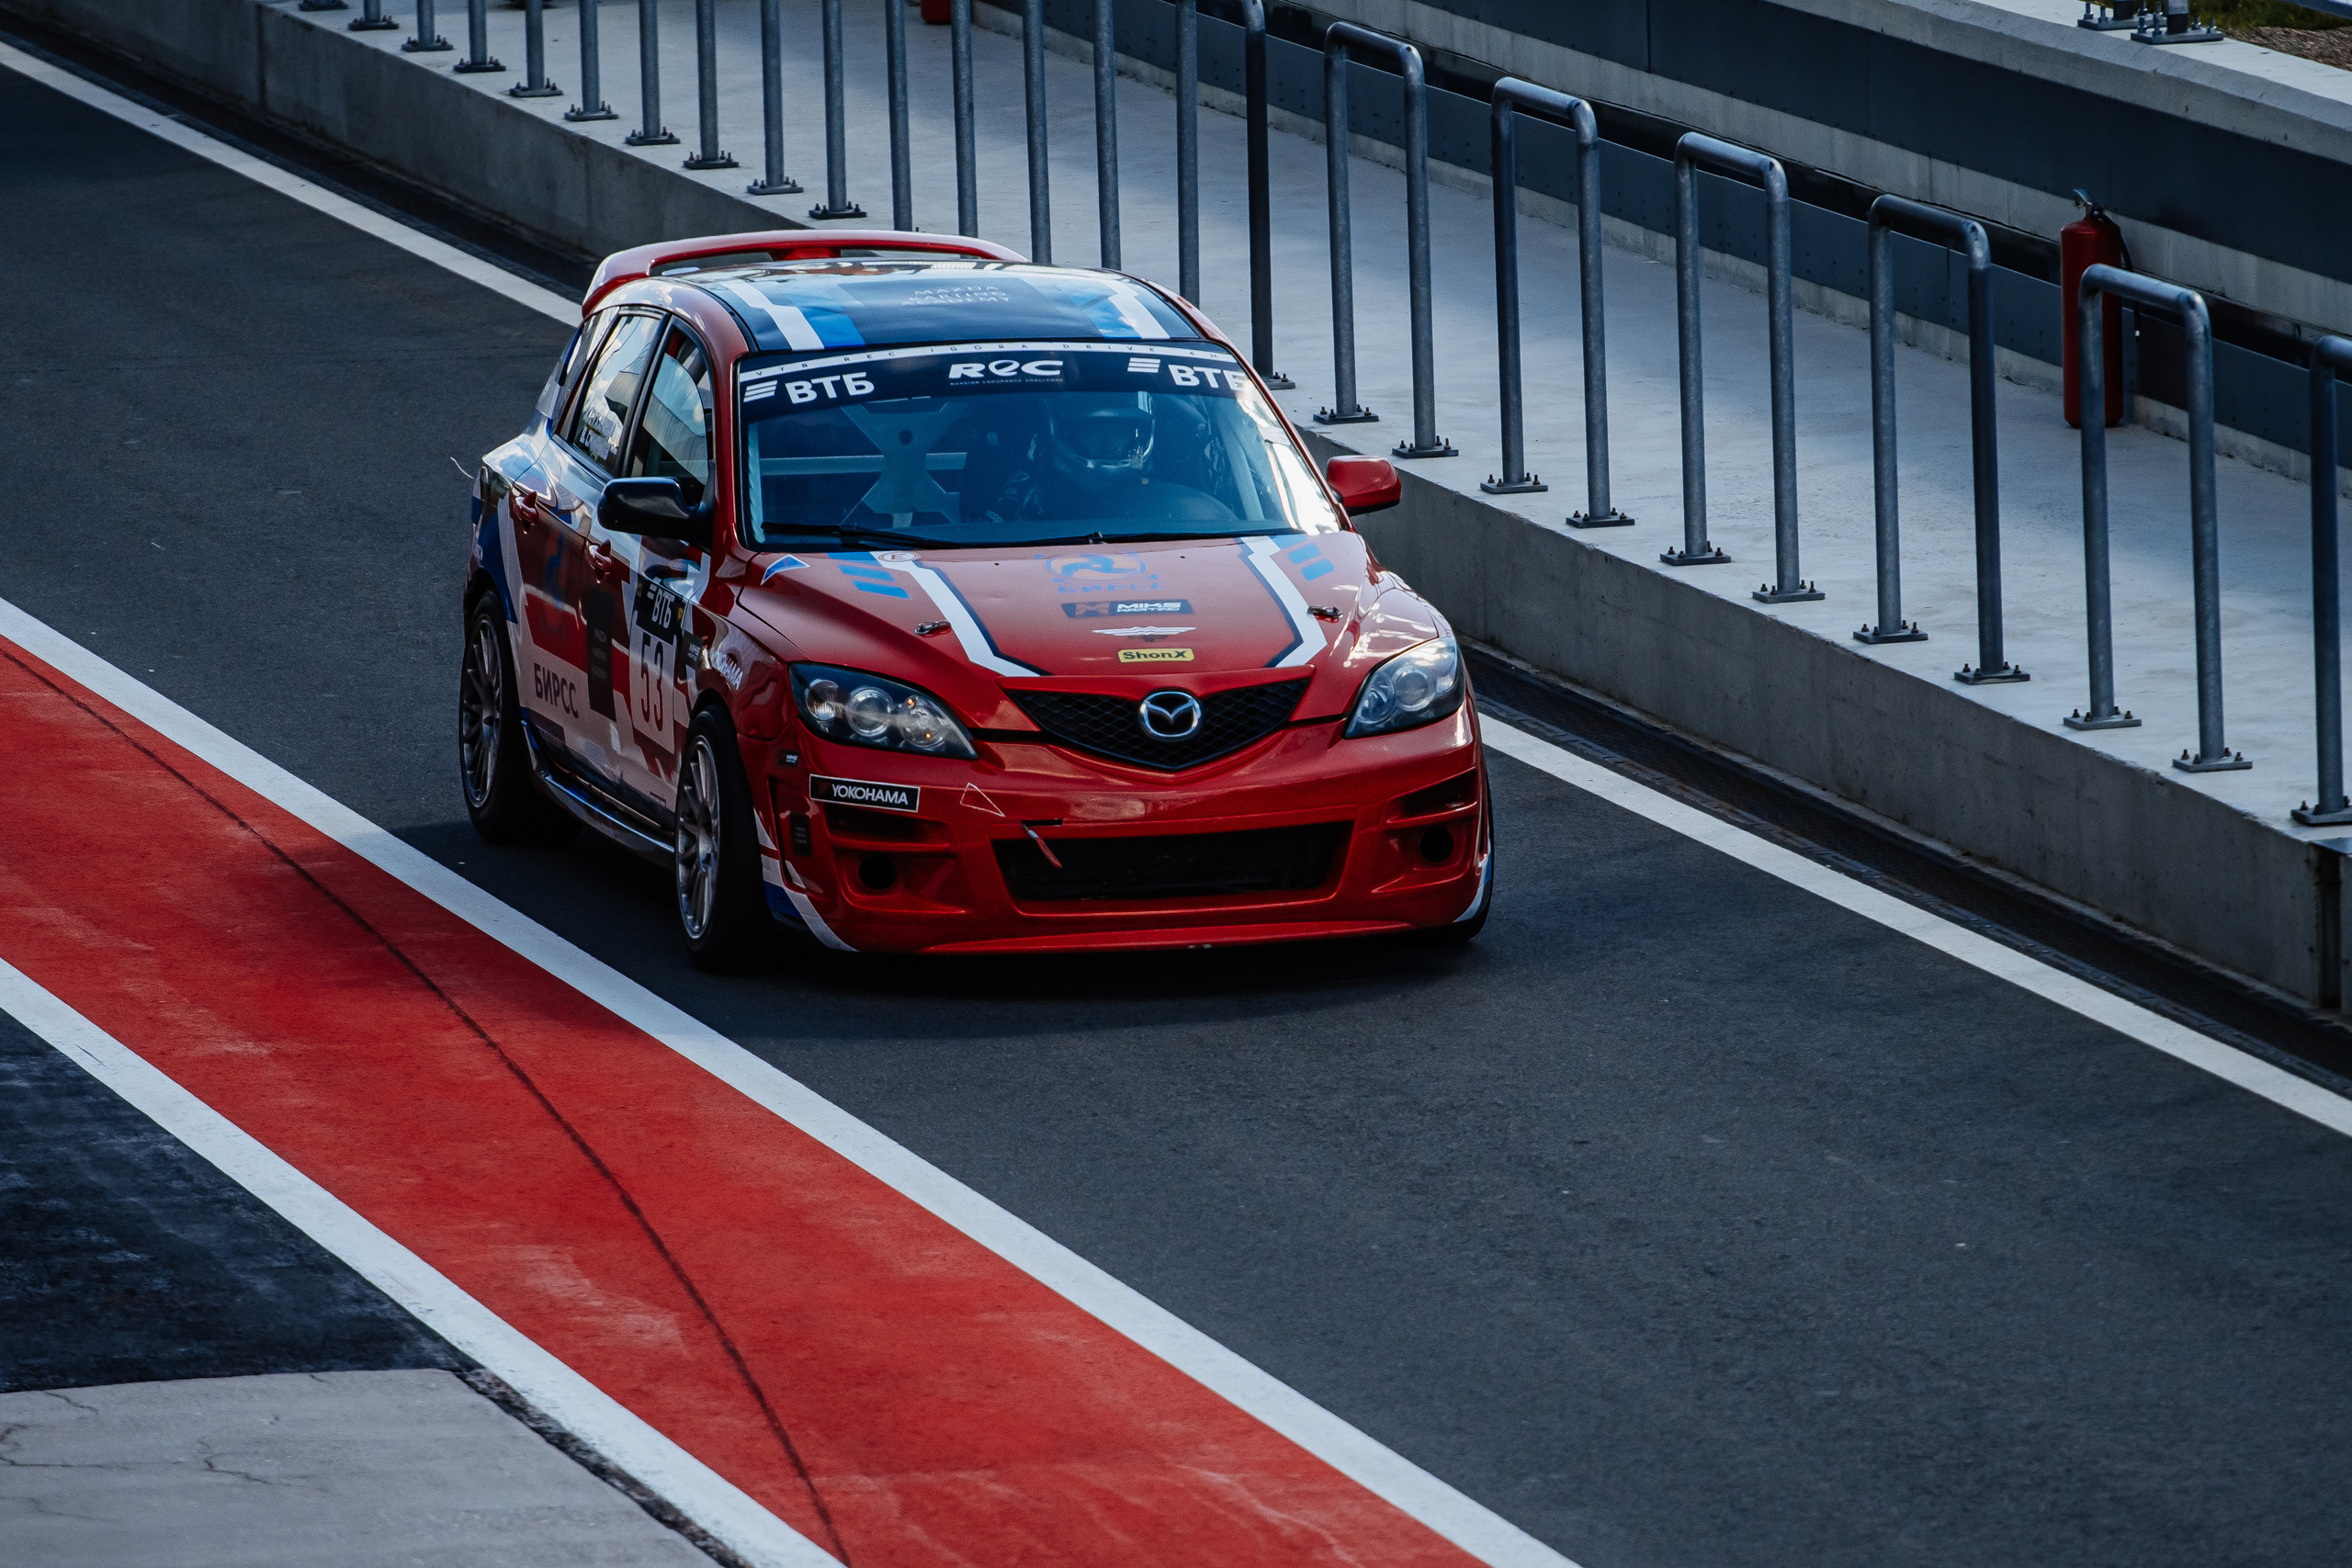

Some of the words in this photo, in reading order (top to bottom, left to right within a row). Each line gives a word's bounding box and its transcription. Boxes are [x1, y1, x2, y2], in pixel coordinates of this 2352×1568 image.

[755, 363, 808, 377] VTB
[843, 351, 896, 362] REC
[931, 344, 1029, 353] IGORA
[1062, 344, 1155, 353] DRIVE
[785, 371, 875, 404] ВТБ
[651, 588, 675, 629] ВТБ
[1122, 649, 1188, 660] ShonX
[533, 661, 580, 719] БИРСС
[640, 631, 664, 732] 53
[831, 784, 909, 806] YOKOHAMA
